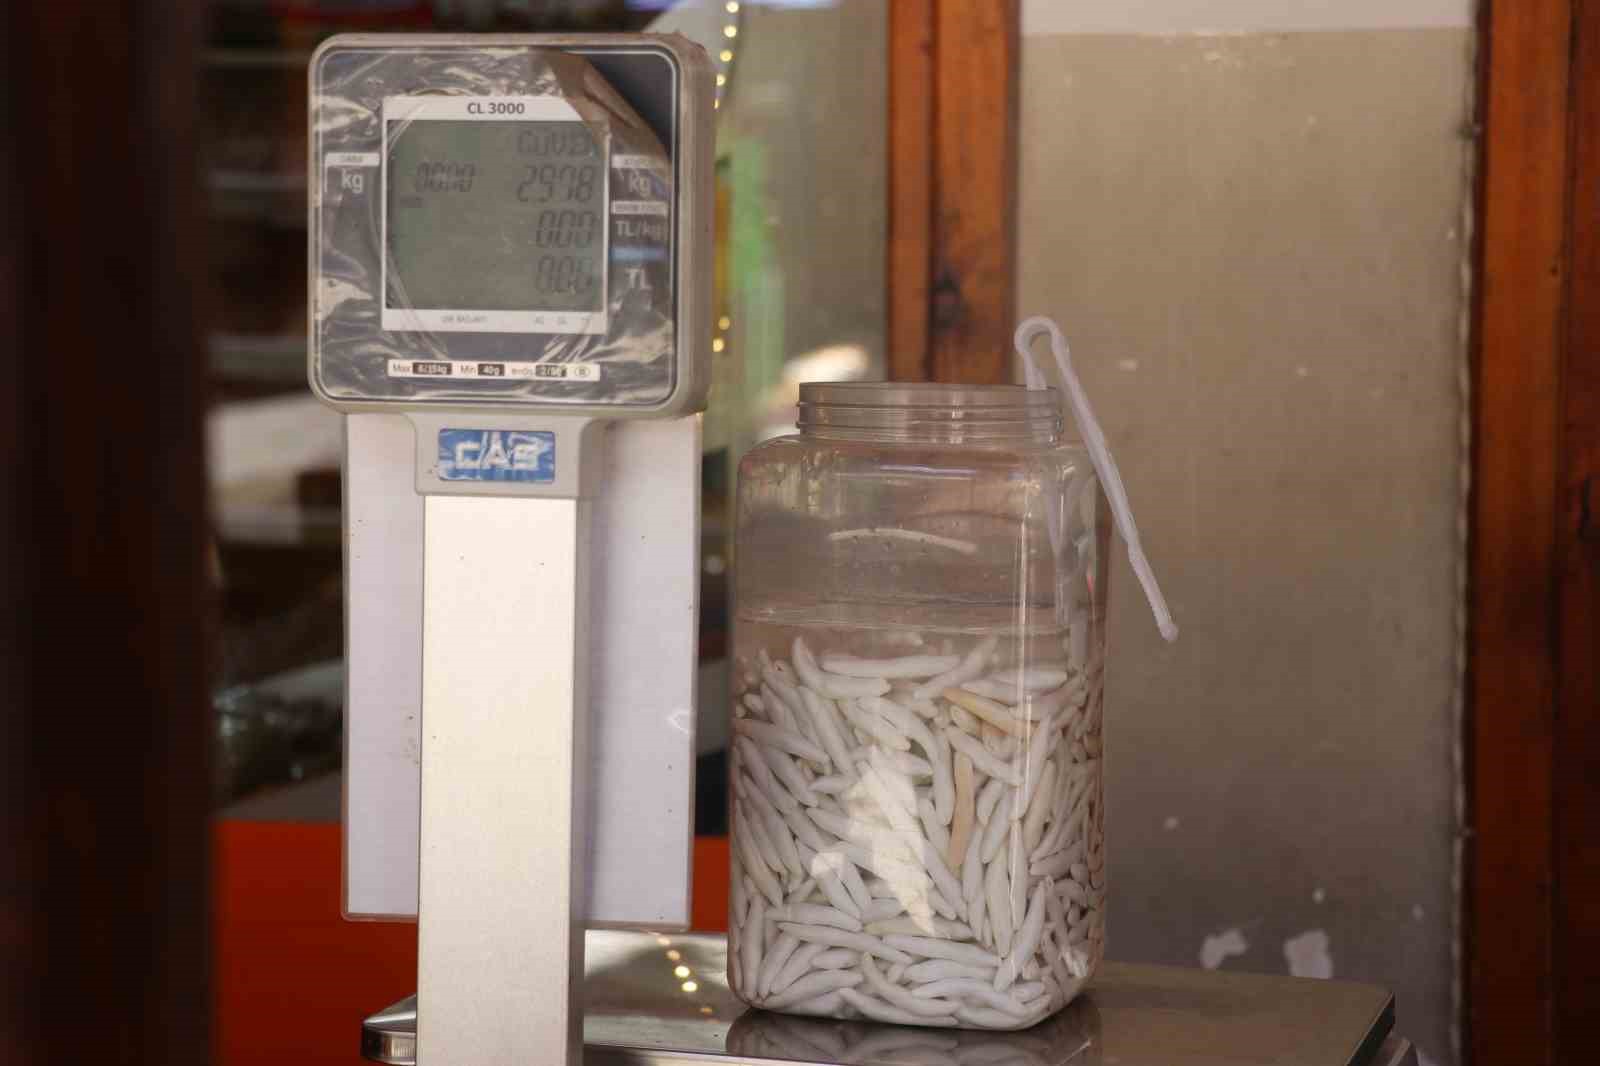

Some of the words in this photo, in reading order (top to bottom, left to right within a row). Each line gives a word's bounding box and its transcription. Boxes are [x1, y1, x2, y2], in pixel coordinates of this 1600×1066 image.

[467, 102, 485, 115] CL
[489, 102, 526, 115] 3000
[341, 168, 364, 194] kg
[629, 170, 651, 198] kg
[625, 267, 652, 291] TL
[393, 363, 411, 373] Max
[460, 365, 476, 374] Min
